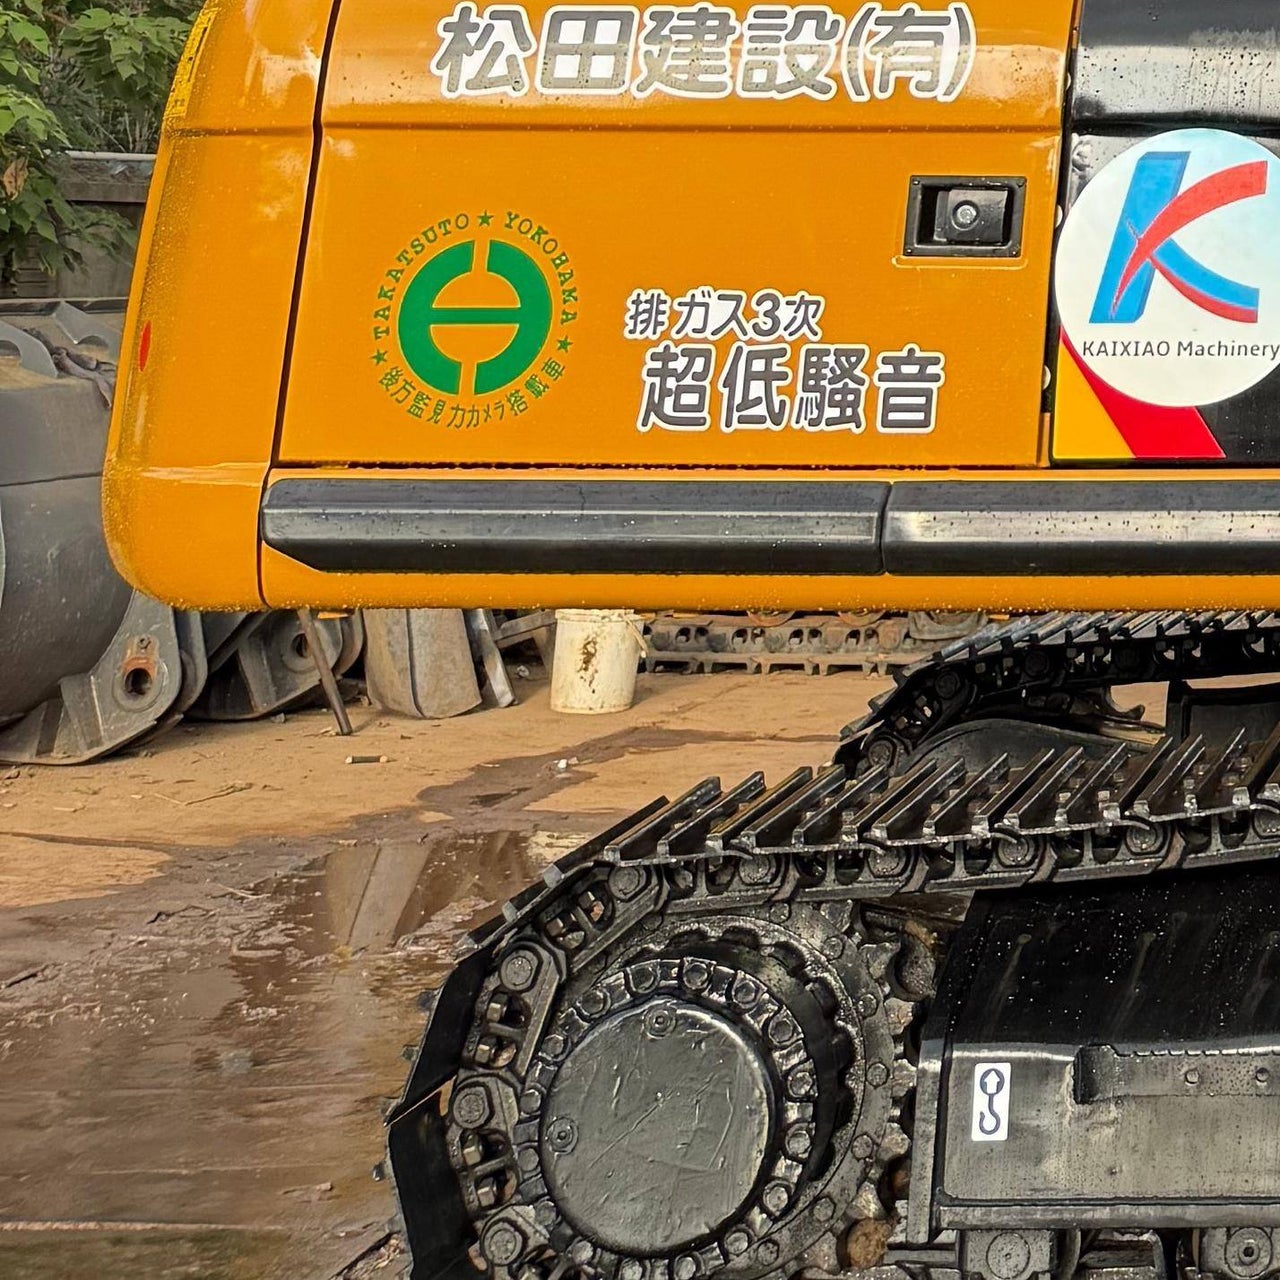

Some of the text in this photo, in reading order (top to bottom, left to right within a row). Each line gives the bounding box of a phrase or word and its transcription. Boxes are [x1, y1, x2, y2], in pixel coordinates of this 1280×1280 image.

[432, 3, 976, 100] 松田建設(有)
[373, 213, 470, 341] TAKATSUTO
[626, 288, 823, 338] 排ガス3次
[638, 341, 943, 432] 超低騒音
[1082, 339, 1280, 361] KAIXIAO Machinery
